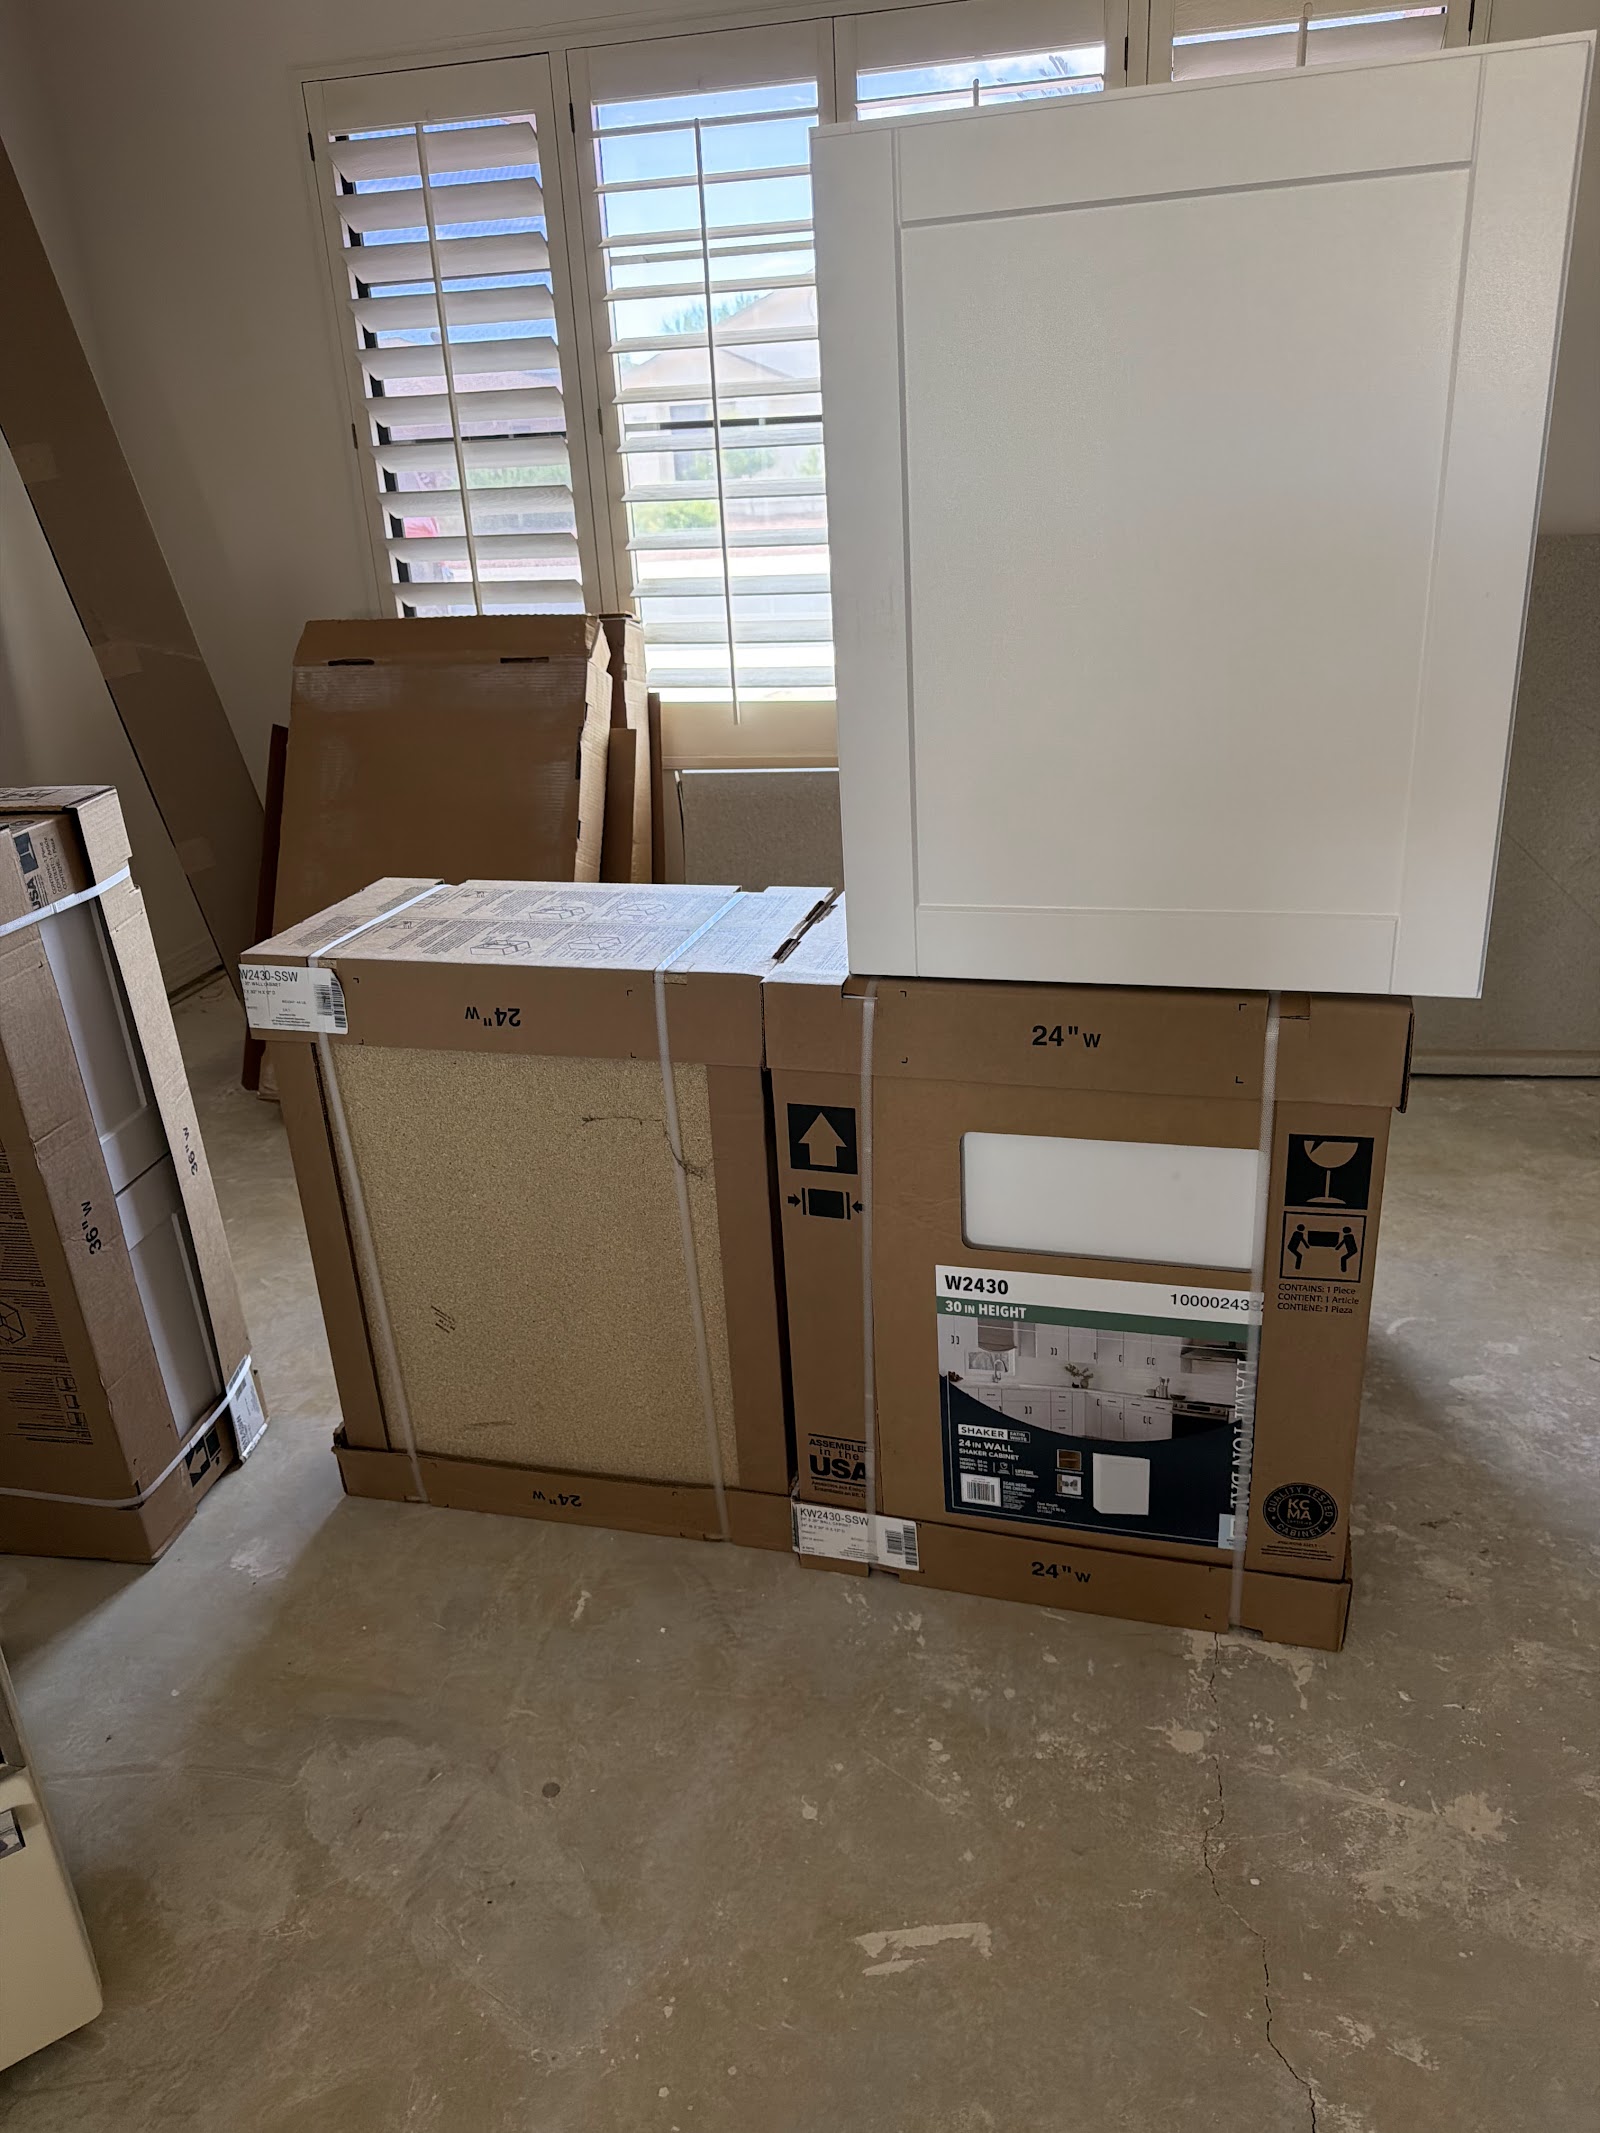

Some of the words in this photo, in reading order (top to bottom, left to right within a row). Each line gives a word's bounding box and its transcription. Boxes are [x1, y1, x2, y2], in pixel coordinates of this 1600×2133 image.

[483, 1007, 521, 1027] 24"
[1031, 1024, 1079, 1047] 24"
[184, 1144, 198, 1176] 36"
[81, 1220, 102, 1255] 36"
[944, 1274, 1009, 1295] W2430
[1278, 1283, 1325, 1293] CONTAINS:
[1333, 1286, 1356, 1295] Piece
[1277, 1292, 1323, 1303] CONTIENT:
[1331, 1296, 1359, 1305] Article
[945, 1300, 962, 1313] 30
[964, 1304, 975, 1314] IN
[978, 1303, 1027, 1319] HEIGHT
[1277, 1302, 1322, 1312] CONTIENE:
[1324, 1305, 1329, 1313] 1
[1331, 1306, 1353, 1314] Pieza
[961, 1426, 1005, 1439] SHAKER
[809, 1438, 867, 1453] ASSEMBLE
[958, 1438, 971, 1448] 24
[972, 1441, 982, 1449] IN
[983, 1442, 1014, 1453] WALL
[819, 1448, 831, 1457] in
[838, 1450, 860, 1461] the
[958, 1448, 988, 1457] SHAKER
[988, 1451, 1020, 1461] CABINET
[809, 1454, 866, 1481] USA
[549, 1493, 582, 1507] 24"
[1267, 1486, 1302, 1513] QUALITY
[1307, 1487, 1334, 1517] TESTED
[800, 1507, 869, 1527] KW2430-SSW
[1276, 1523, 1322, 1538] CABINET
[1031, 1561, 1072, 1579] 24"
